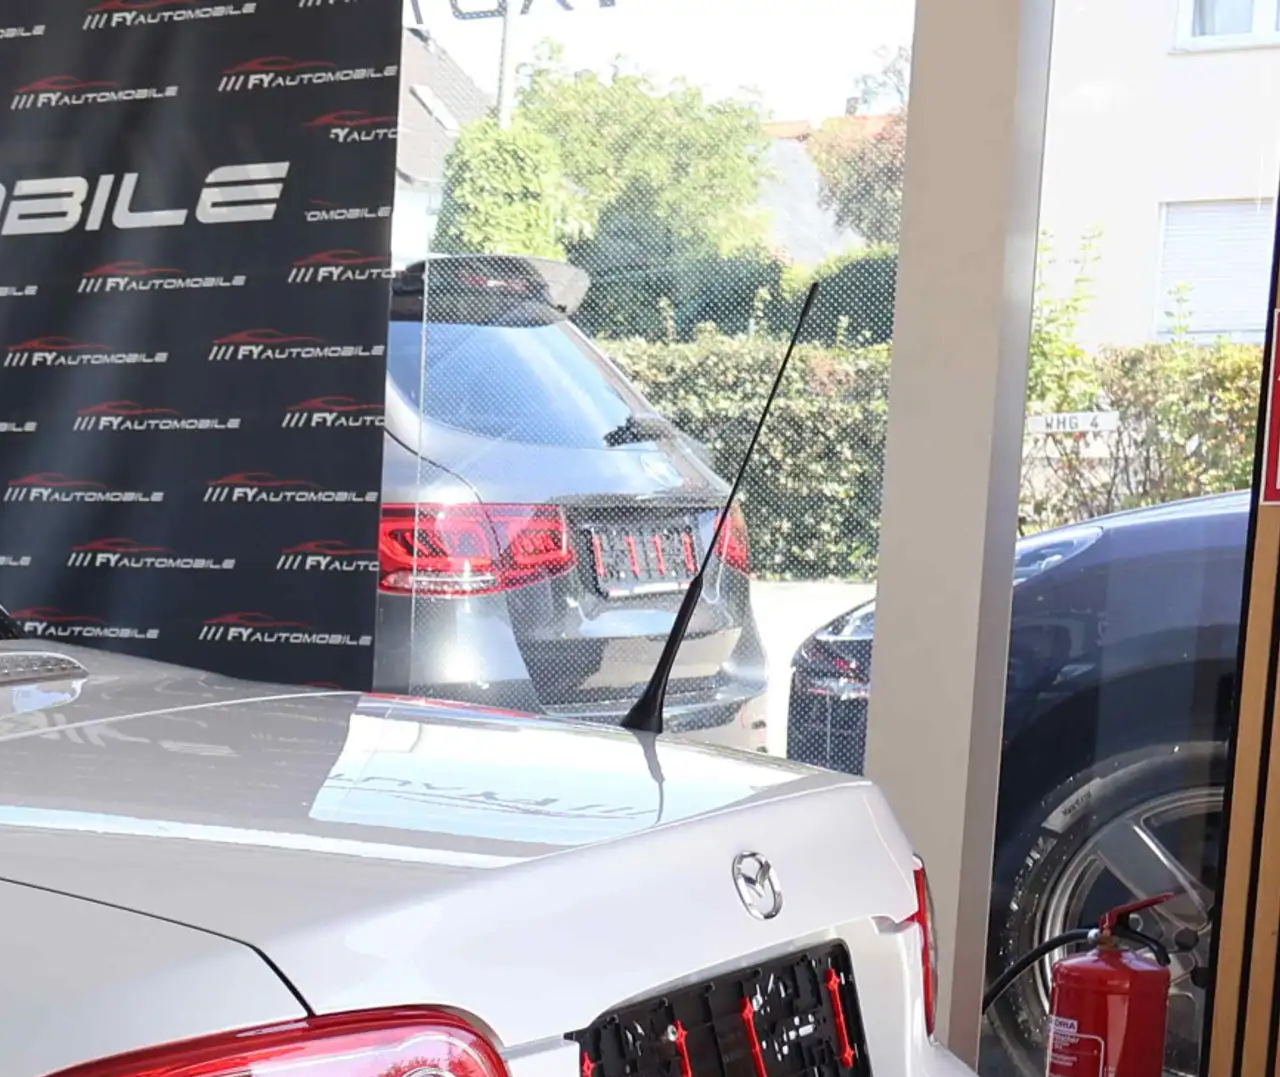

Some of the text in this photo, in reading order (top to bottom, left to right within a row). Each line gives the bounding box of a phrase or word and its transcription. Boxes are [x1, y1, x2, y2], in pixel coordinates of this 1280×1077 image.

[111, 2, 256, 28] FYAUTOMOBILE
[248, 65, 397, 90] FYAUTOMOBILE
[37, 86, 179, 108] FYAUTOMOBILE
[105, 274, 246, 293] FYAUTOMOBILE
[31, 351, 168, 367] FYAUTOMOBILE
[237, 344, 385, 361] FYAUTOMOBILE
[98, 415, 241, 431] FYAUTOMOBILE
[29, 488, 165, 502] FYAUTOMOBILE
[232, 487, 379, 502] FYAUTOMOBILE
[95, 552, 236, 570] FYAUTOMOBILE
[23, 621, 160, 639] FYAUTOMOBILE
[227, 627, 372, 646] FYAUTOMOBILE
